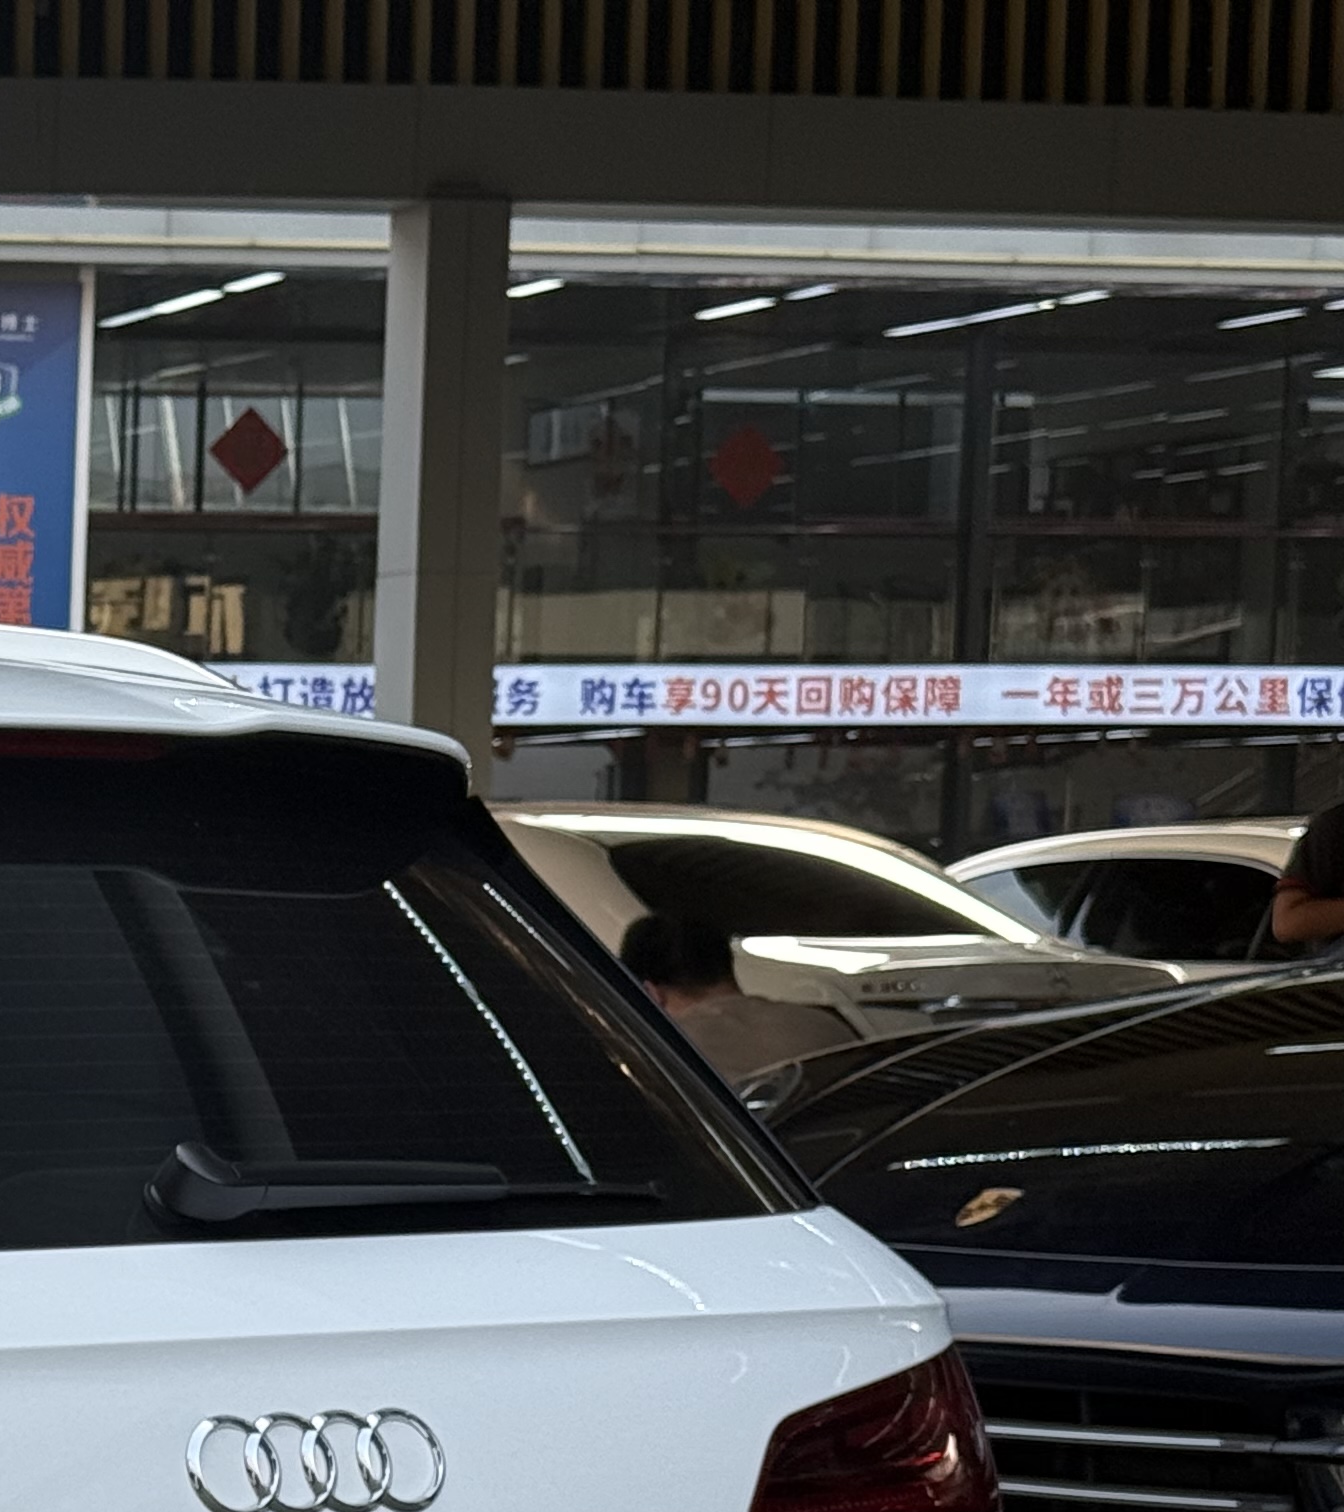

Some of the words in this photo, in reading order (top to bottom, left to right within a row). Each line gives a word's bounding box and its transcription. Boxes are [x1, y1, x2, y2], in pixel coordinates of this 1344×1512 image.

[579, 674, 963, 718] 购车享90天回购保障
[1000, 674, 1344, 719] 一年或三万公里保
